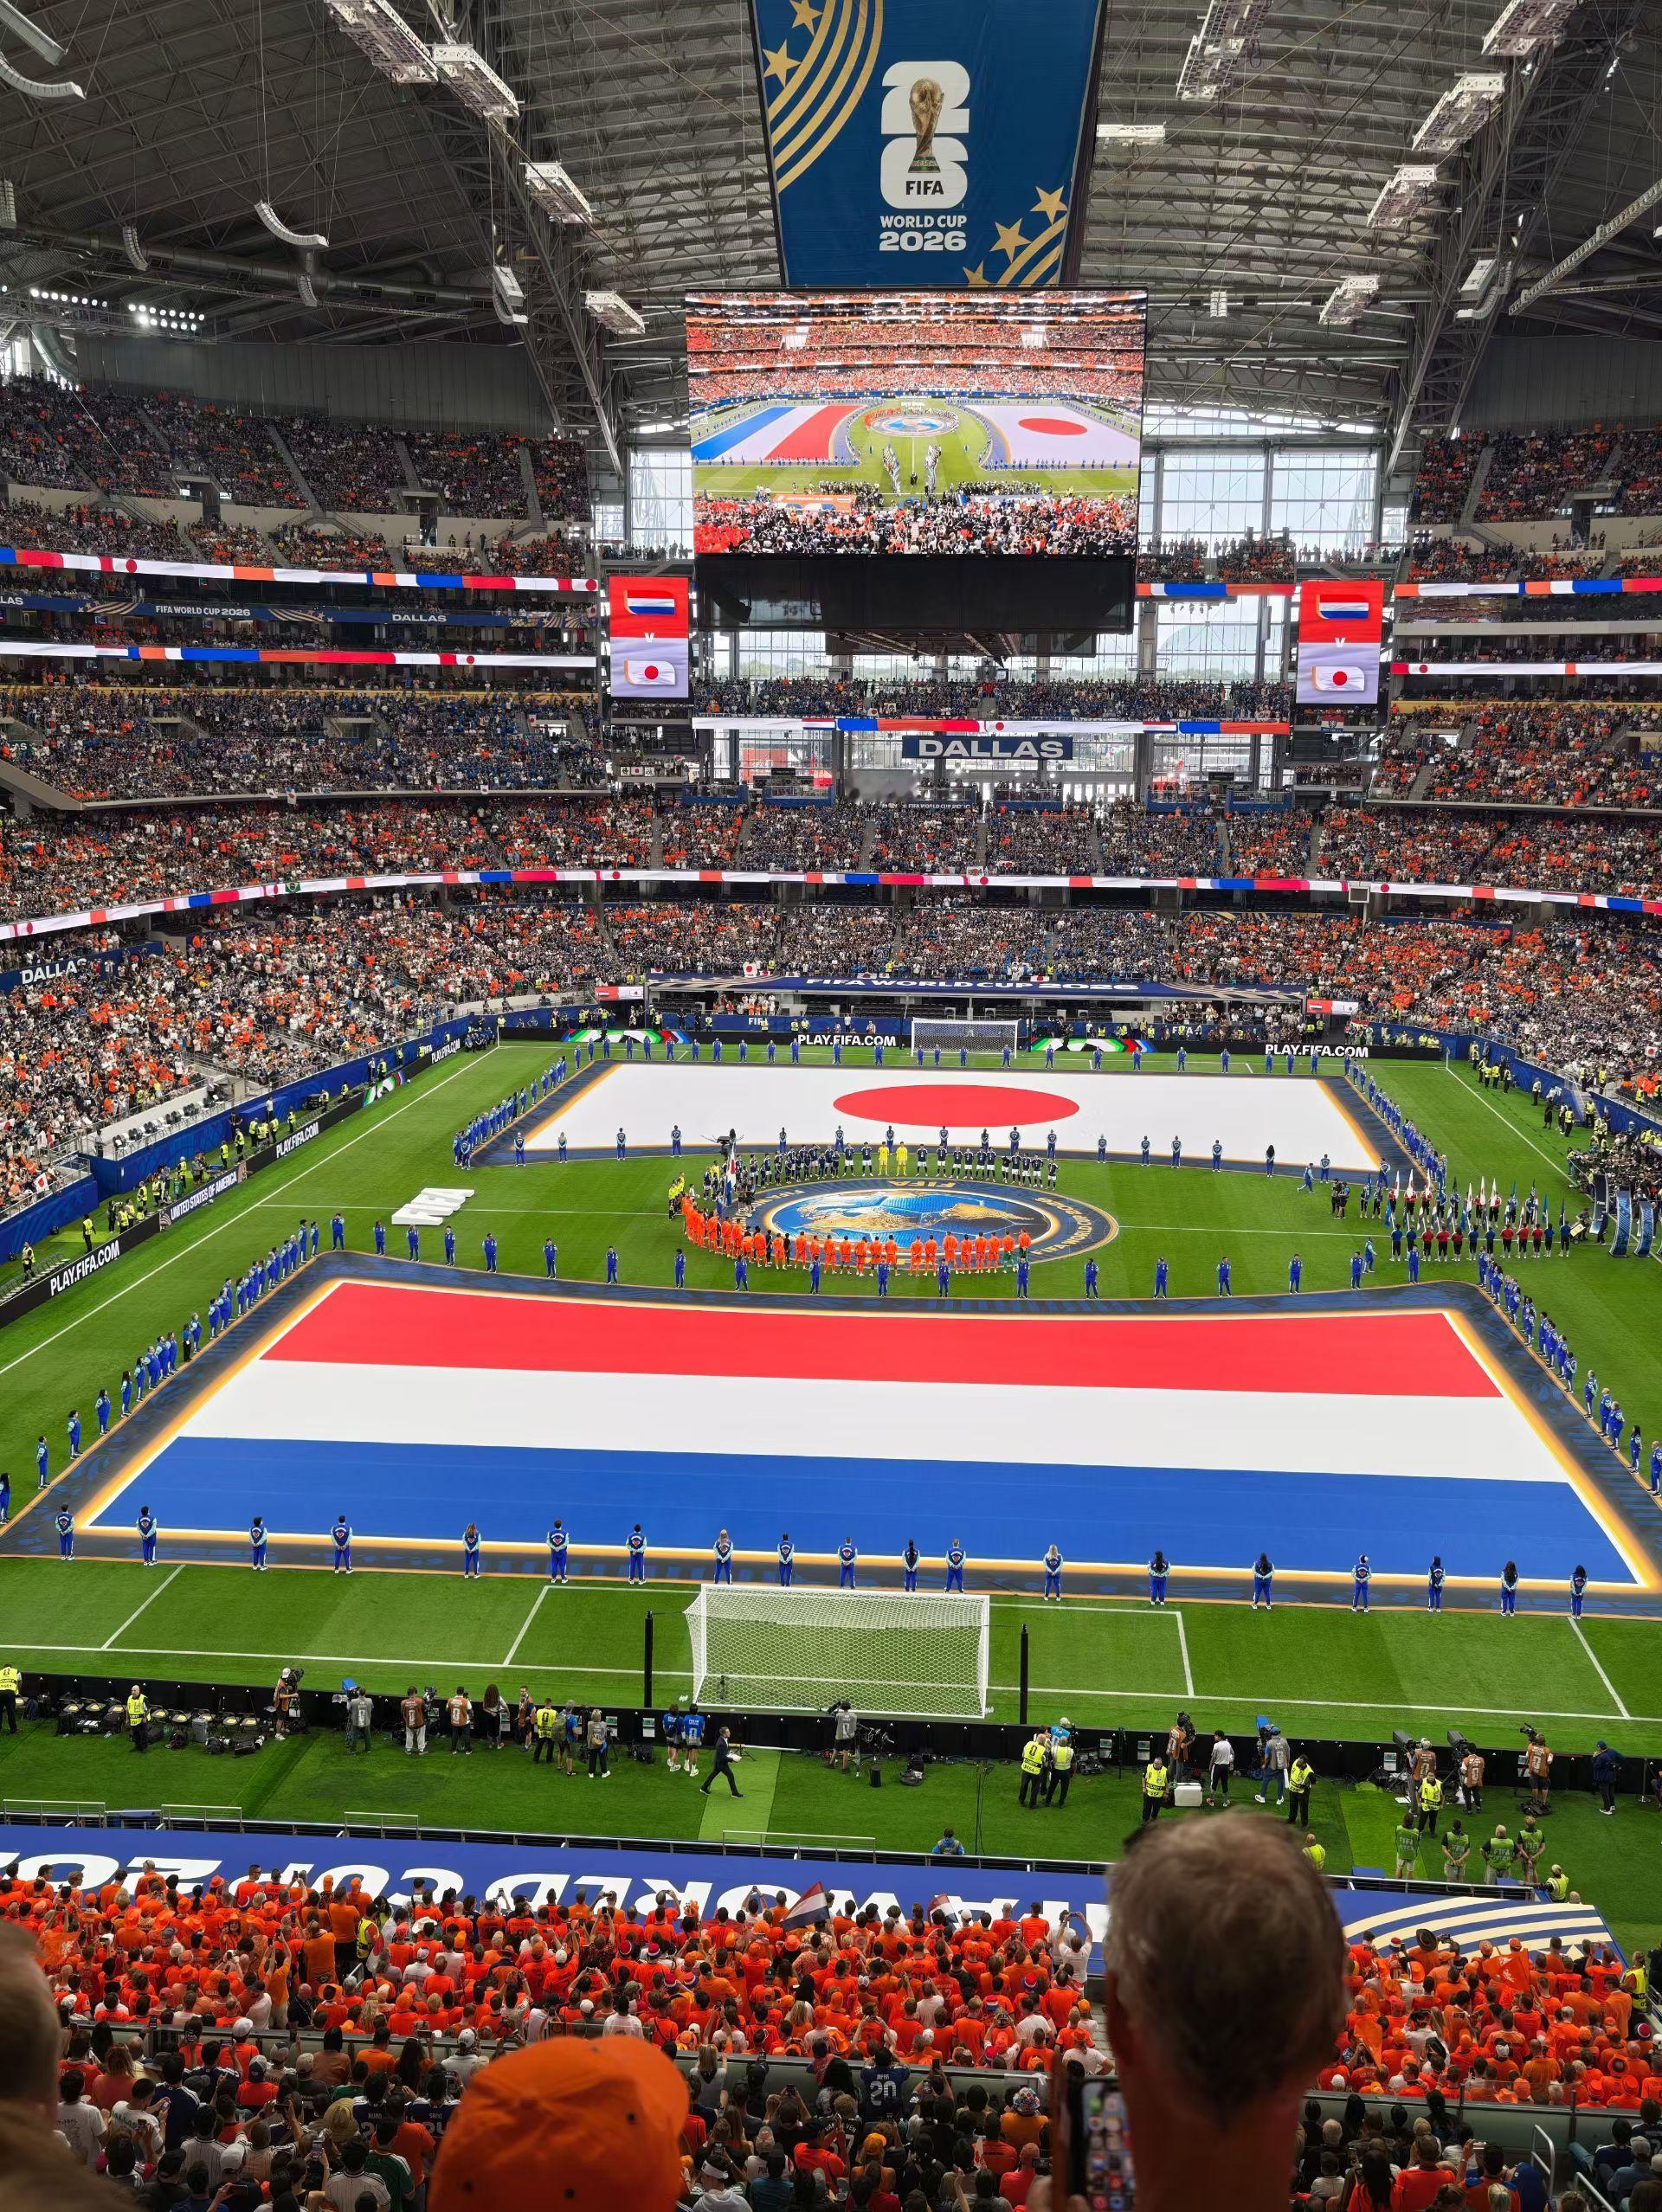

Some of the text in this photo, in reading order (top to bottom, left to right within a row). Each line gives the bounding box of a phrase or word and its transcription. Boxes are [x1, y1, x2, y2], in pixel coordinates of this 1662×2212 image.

[905, 180, 944, 196] FIFA
[879, 215, 967, 228] WORLD CUP
[879, 230, 967, 252] 2026
[156, 605, 173, 614] FIFA
[173, 606, 203, 614] WORLD
[203, 607, 221, 615] CUP
[391, 614, 448, 622] DALLAS
[918, 739, 1064, 758] DALLAS
[797, 1034, 896, 1046] PLAY.FIFA.COM
[431, 1038, 461, 1064] PLAY.FIFA.COM
[1265, 1044, 1369, 1058] PLAY.FIFA.COM
[275, 1122, 319, 1159] PLAY.FIFA.COM
[171, 1171, 237, 1220] UNITED STATES OF AMERICA
[1030, 1244, 1070, 1255] FIFA
[50, 1239, 120, 1296] PLAY.FIFA.COM
[869, 2080, 897, 2106] 20
